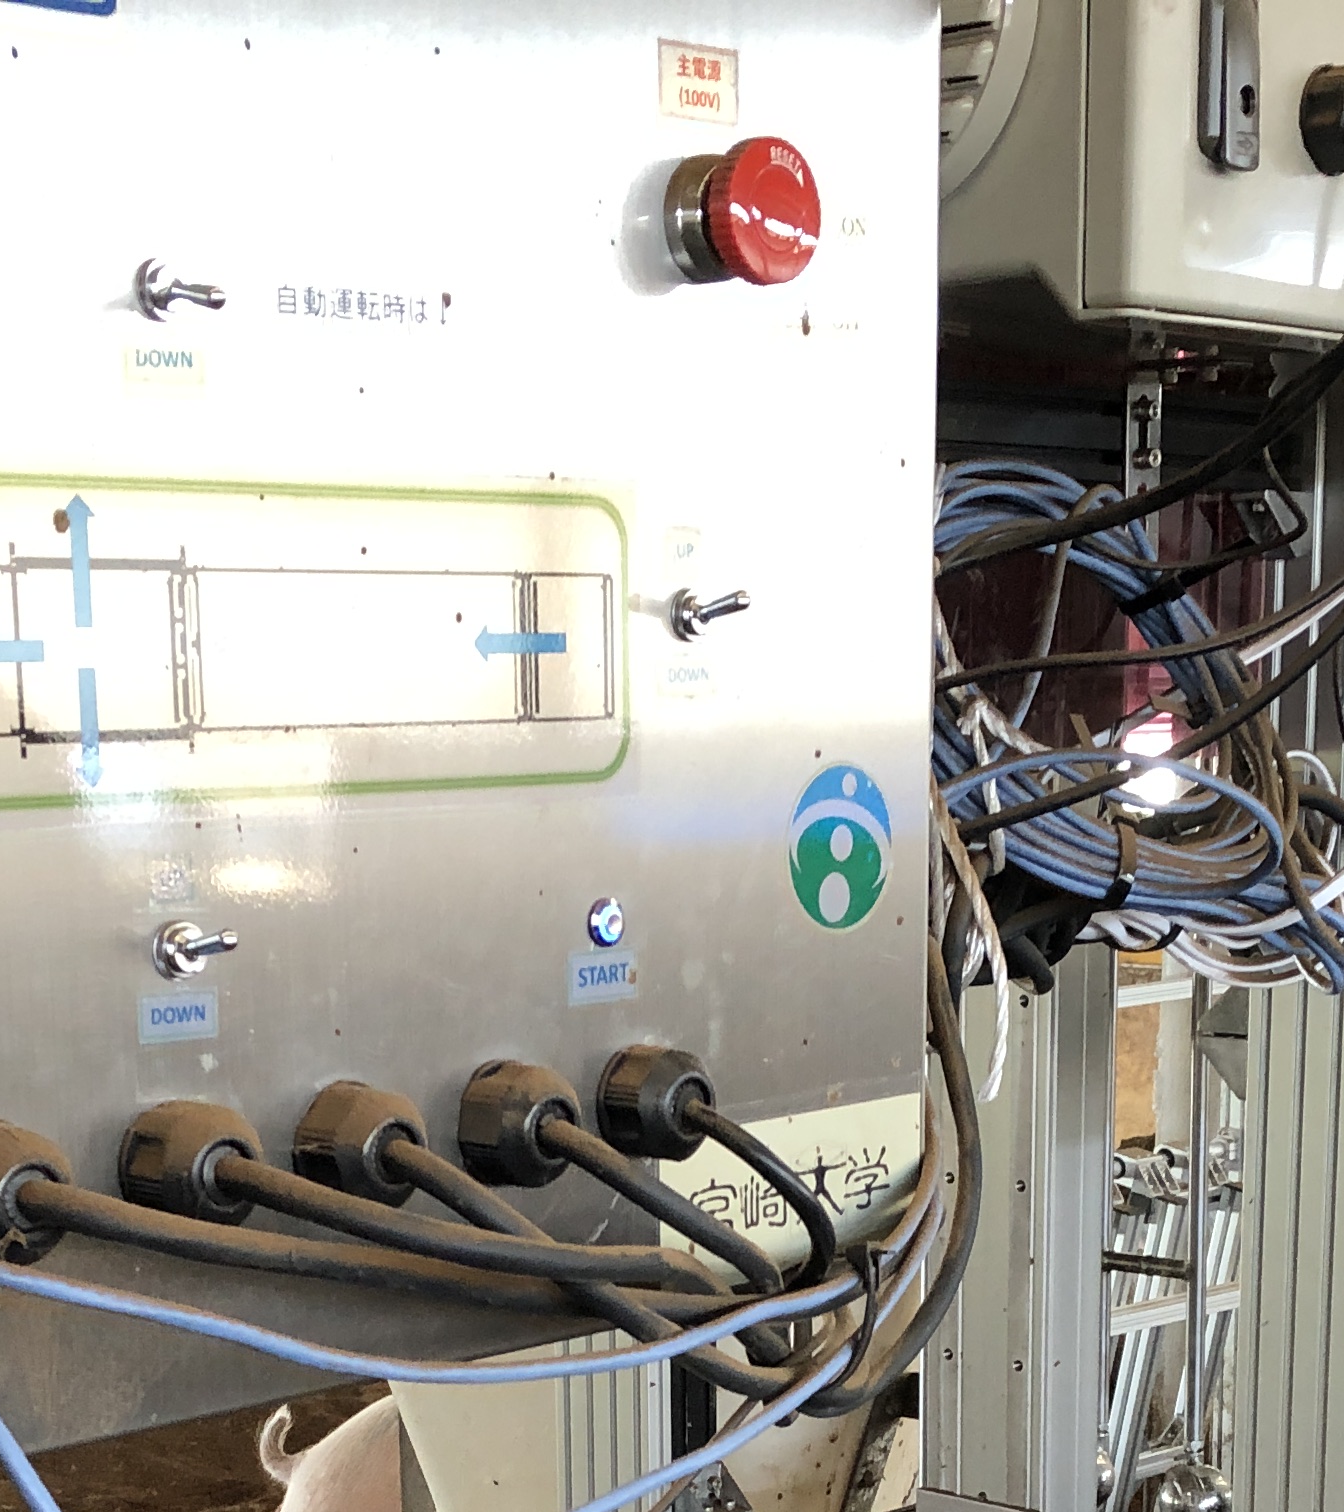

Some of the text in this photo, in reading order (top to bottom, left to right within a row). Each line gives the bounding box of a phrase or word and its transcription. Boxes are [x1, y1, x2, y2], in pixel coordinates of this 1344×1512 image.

[676, 53, 722, 82] 主電源
[678, 85, 721, 112] (100V)
[769, 145, 802, 172] RESET
[135, 348, 193, 369] DOWN
[676, 542, 694, 559] UP
[668, 667, 709, 683] DOWN
[578, 962, 629, 988] START
[151, 1004, 206, 1026] DOWN
